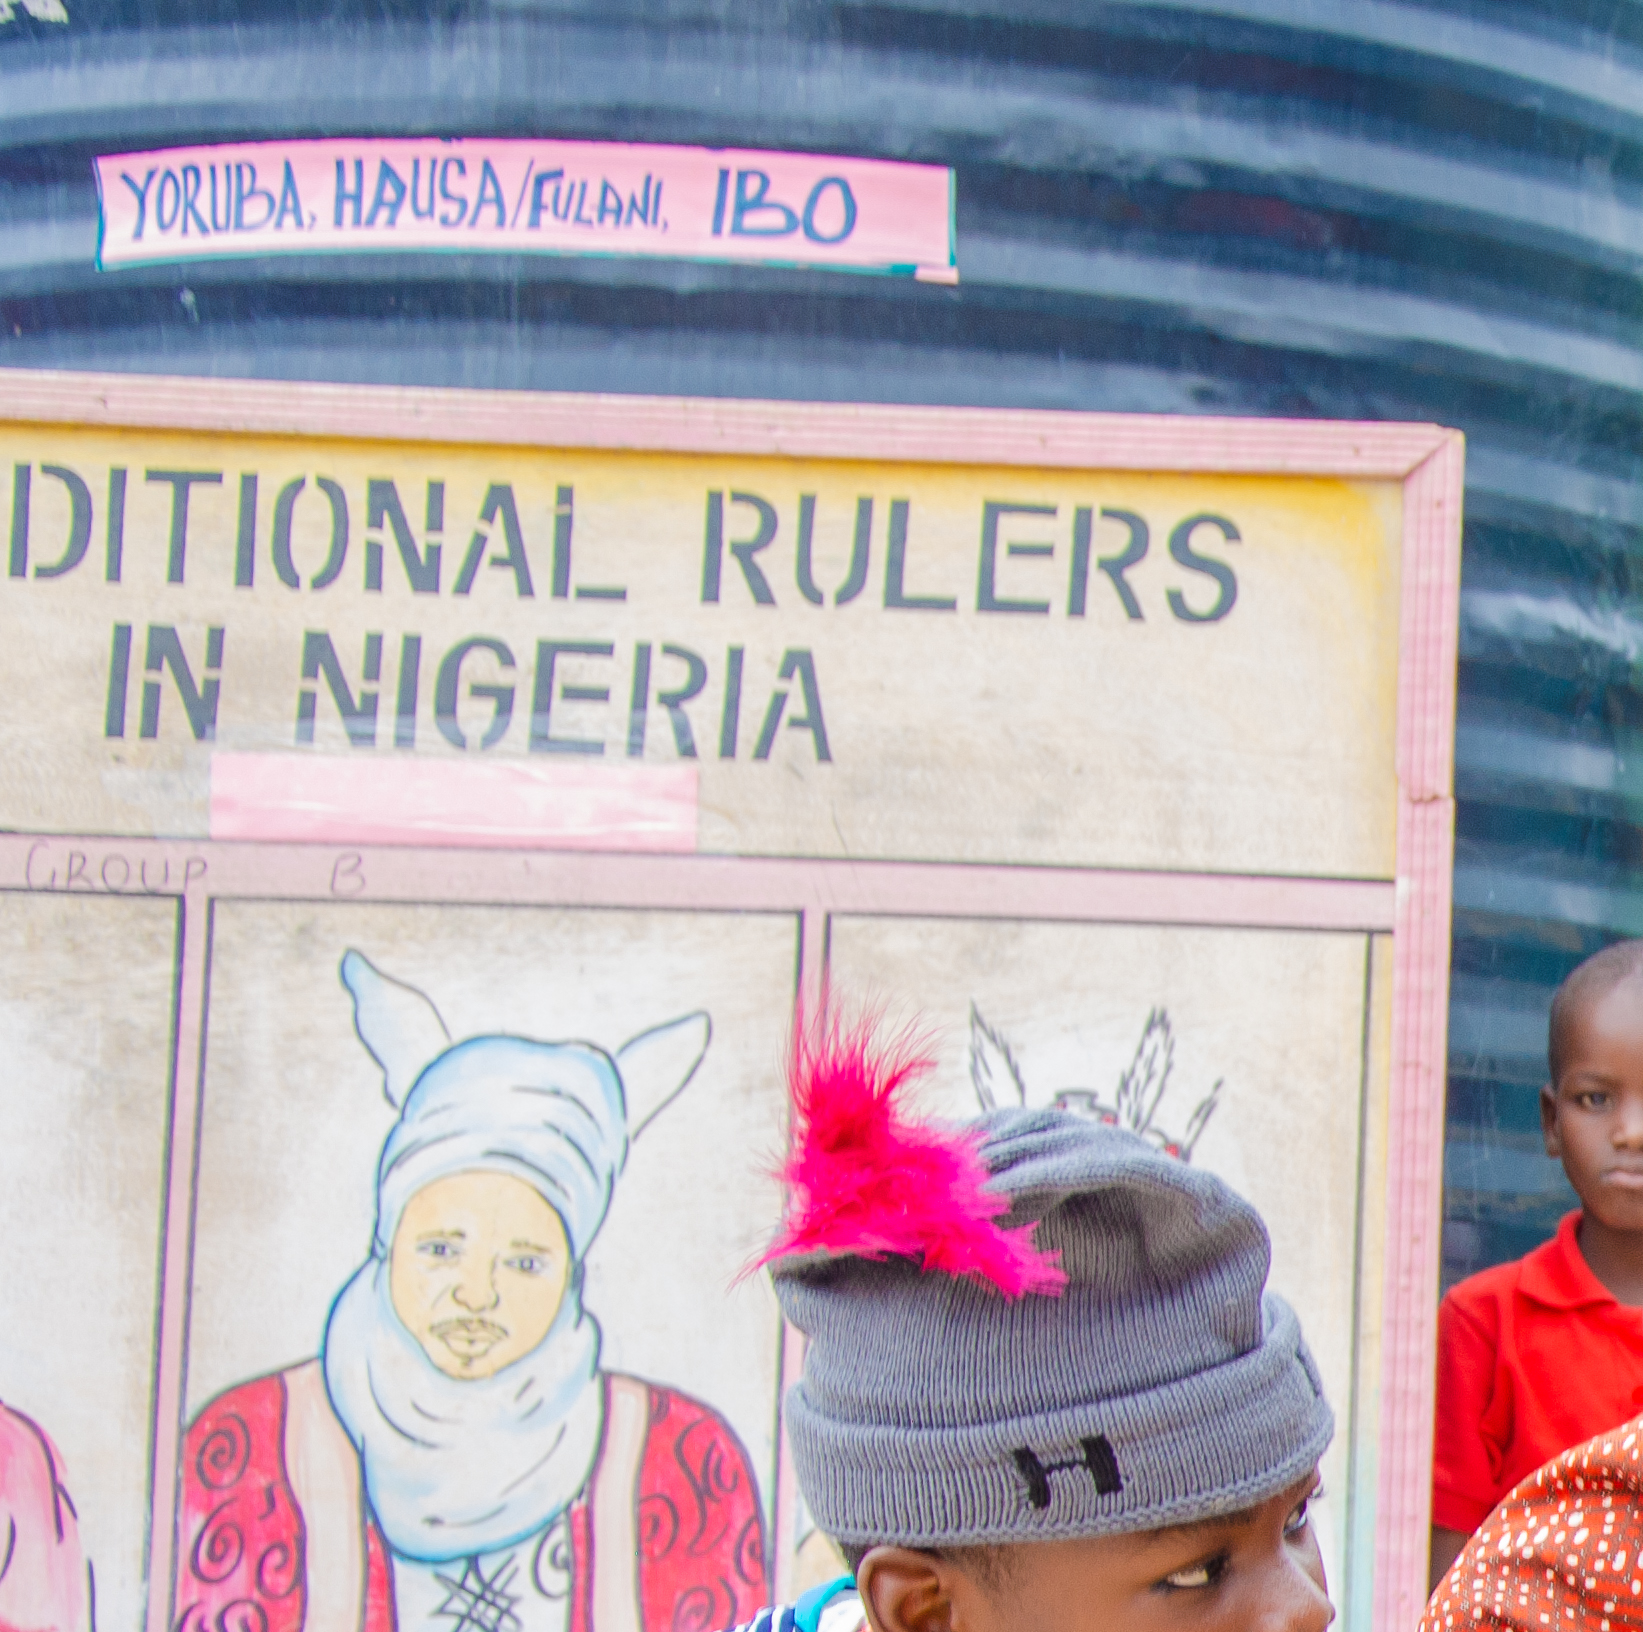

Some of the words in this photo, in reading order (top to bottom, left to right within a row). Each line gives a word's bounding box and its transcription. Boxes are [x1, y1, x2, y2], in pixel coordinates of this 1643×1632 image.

[120, 158, 316, 240] YORUBA,
[711, 167, 858, 245] IBO
[9, 463, 627, 601] DITIONAL
[700, 489, 1241, 624] RULERS
[105, 623, 225, 741] IN
[295, 630, 833, 763] NIGERIA
[26, 839, 207, 893] GROUP
[331, 853, 366, 896] B
[1011, 1433, 1123, 1508] H
